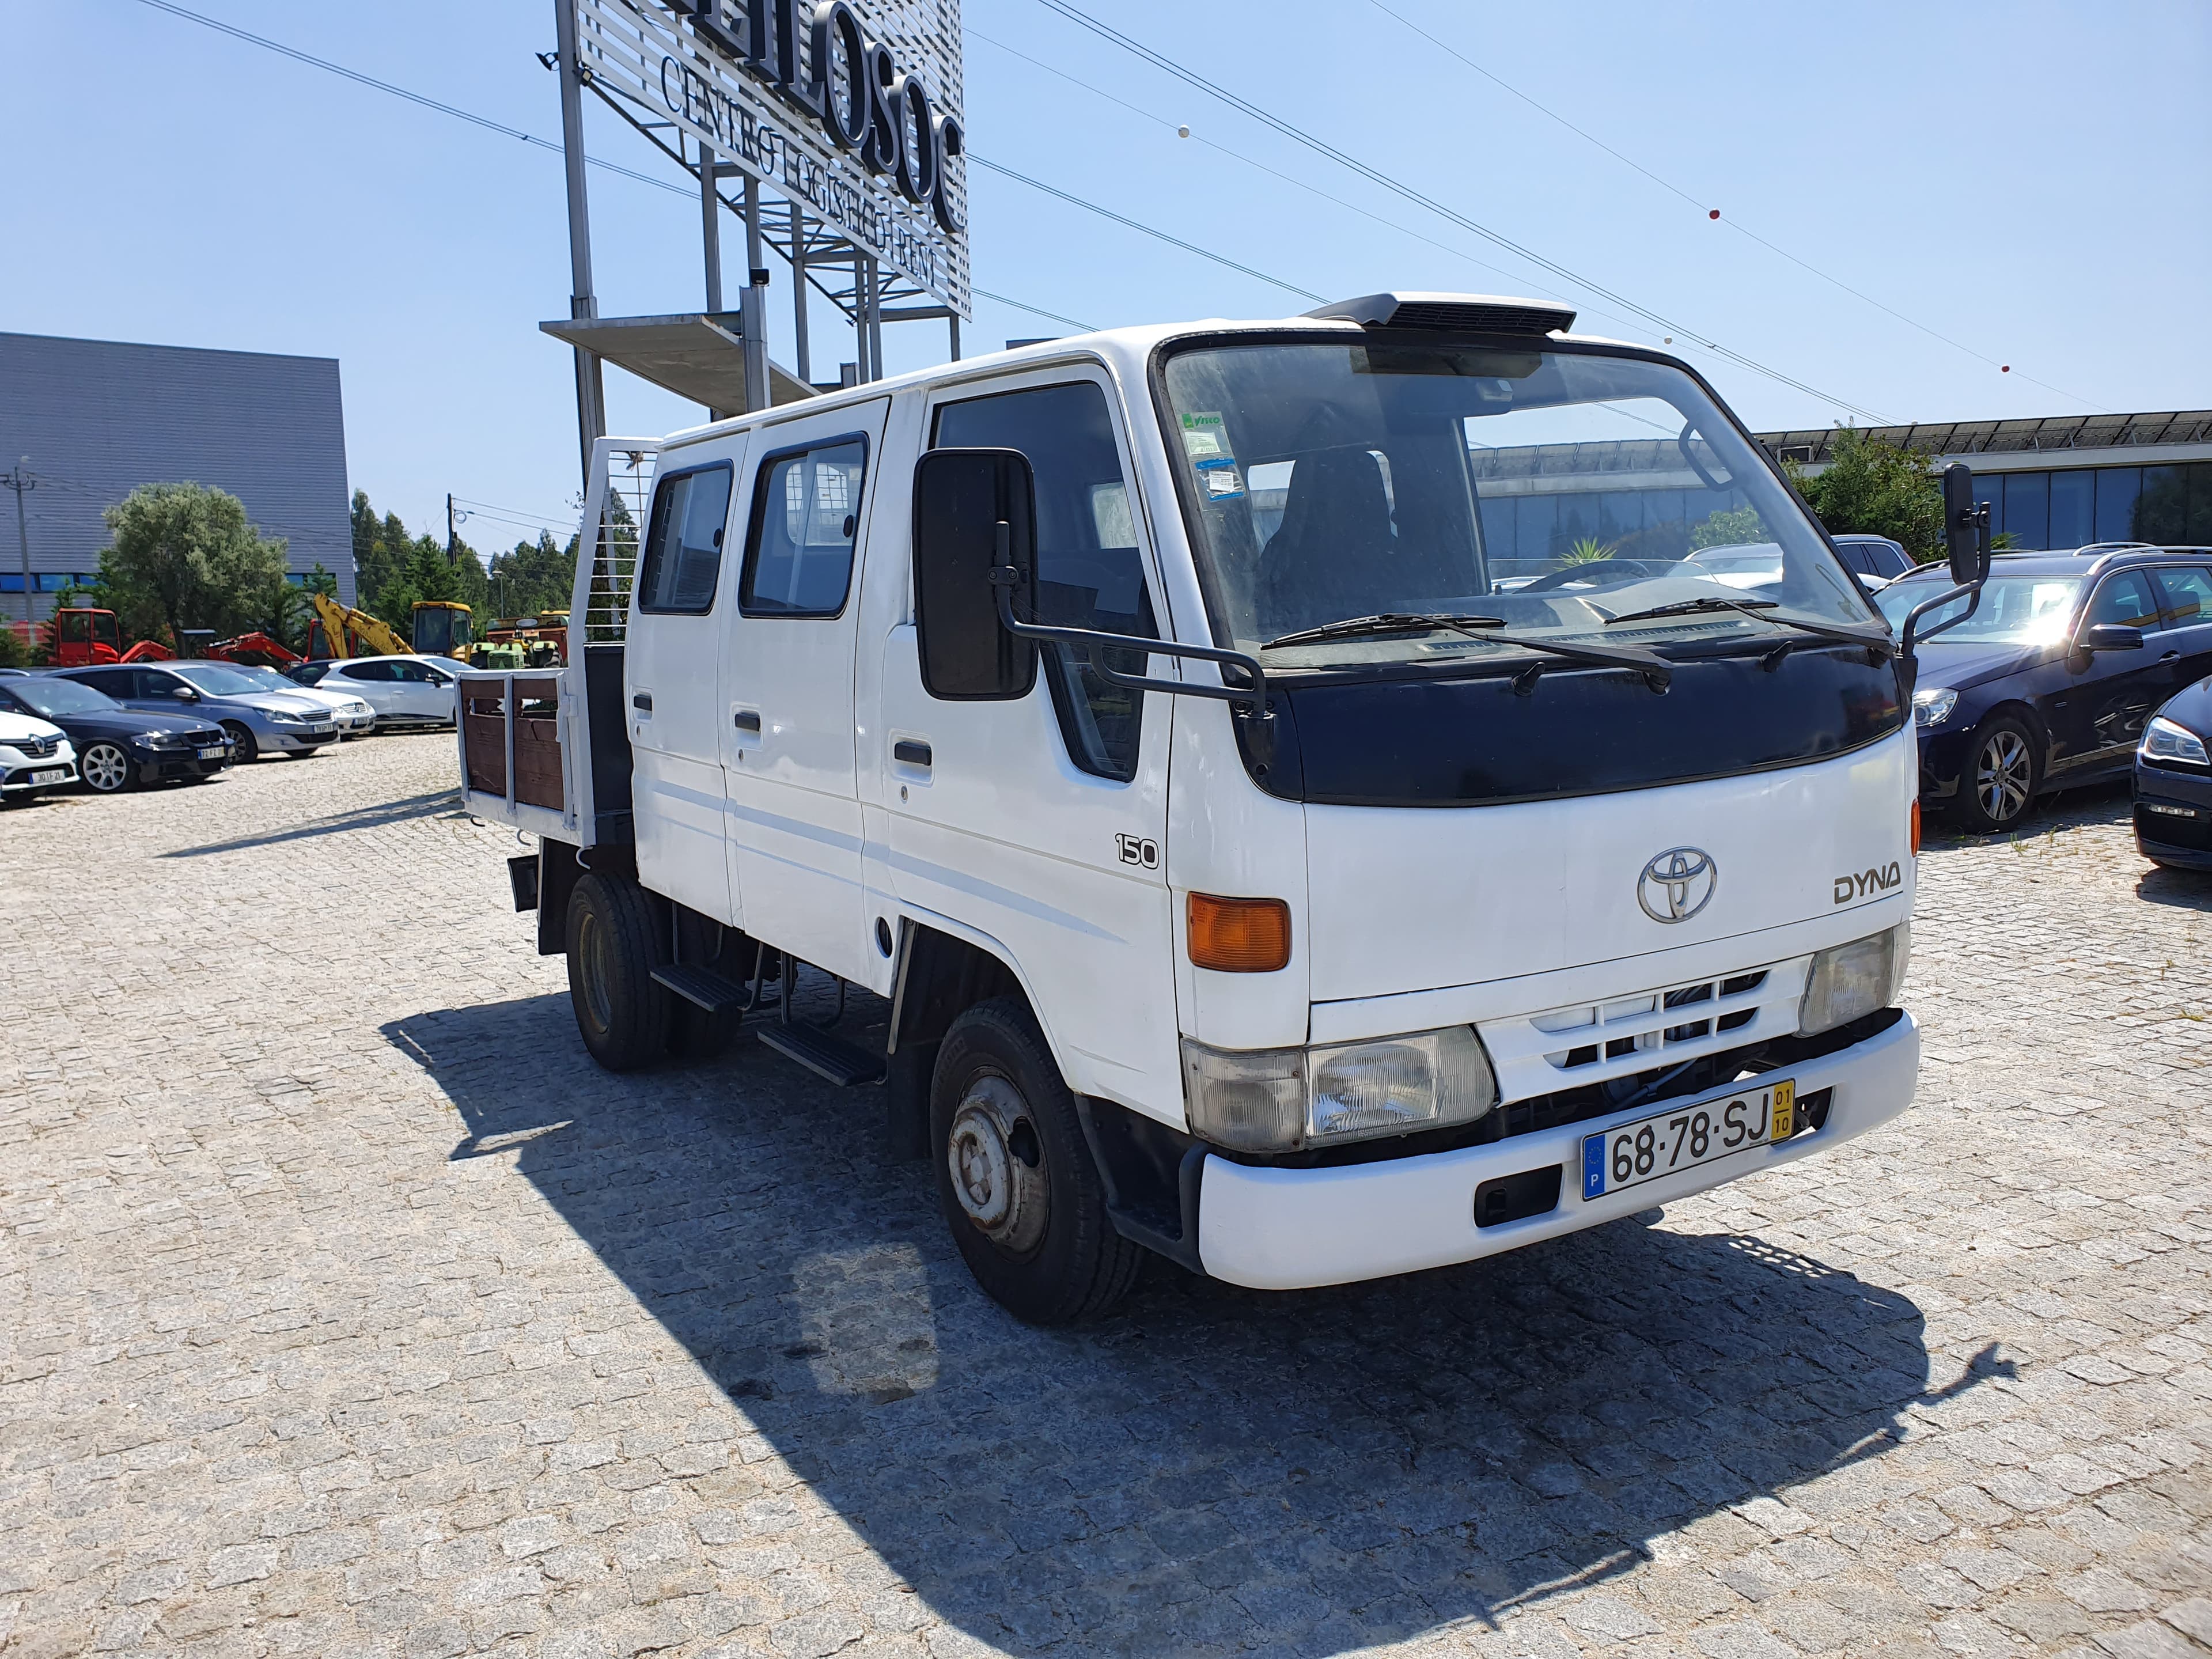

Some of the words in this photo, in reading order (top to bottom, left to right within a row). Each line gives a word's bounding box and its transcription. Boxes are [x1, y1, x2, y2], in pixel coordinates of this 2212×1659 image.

[661, 56, 775, 175] CENTRO
[1115, 833, 1159, 870] 150
[1834, 861, 1901, 904] DYNA
[1775, 1088, 1790, 1105] 01
[1775, 1116, 1789, 1133] 10
[1590, 1173, 1599, 1187] P
